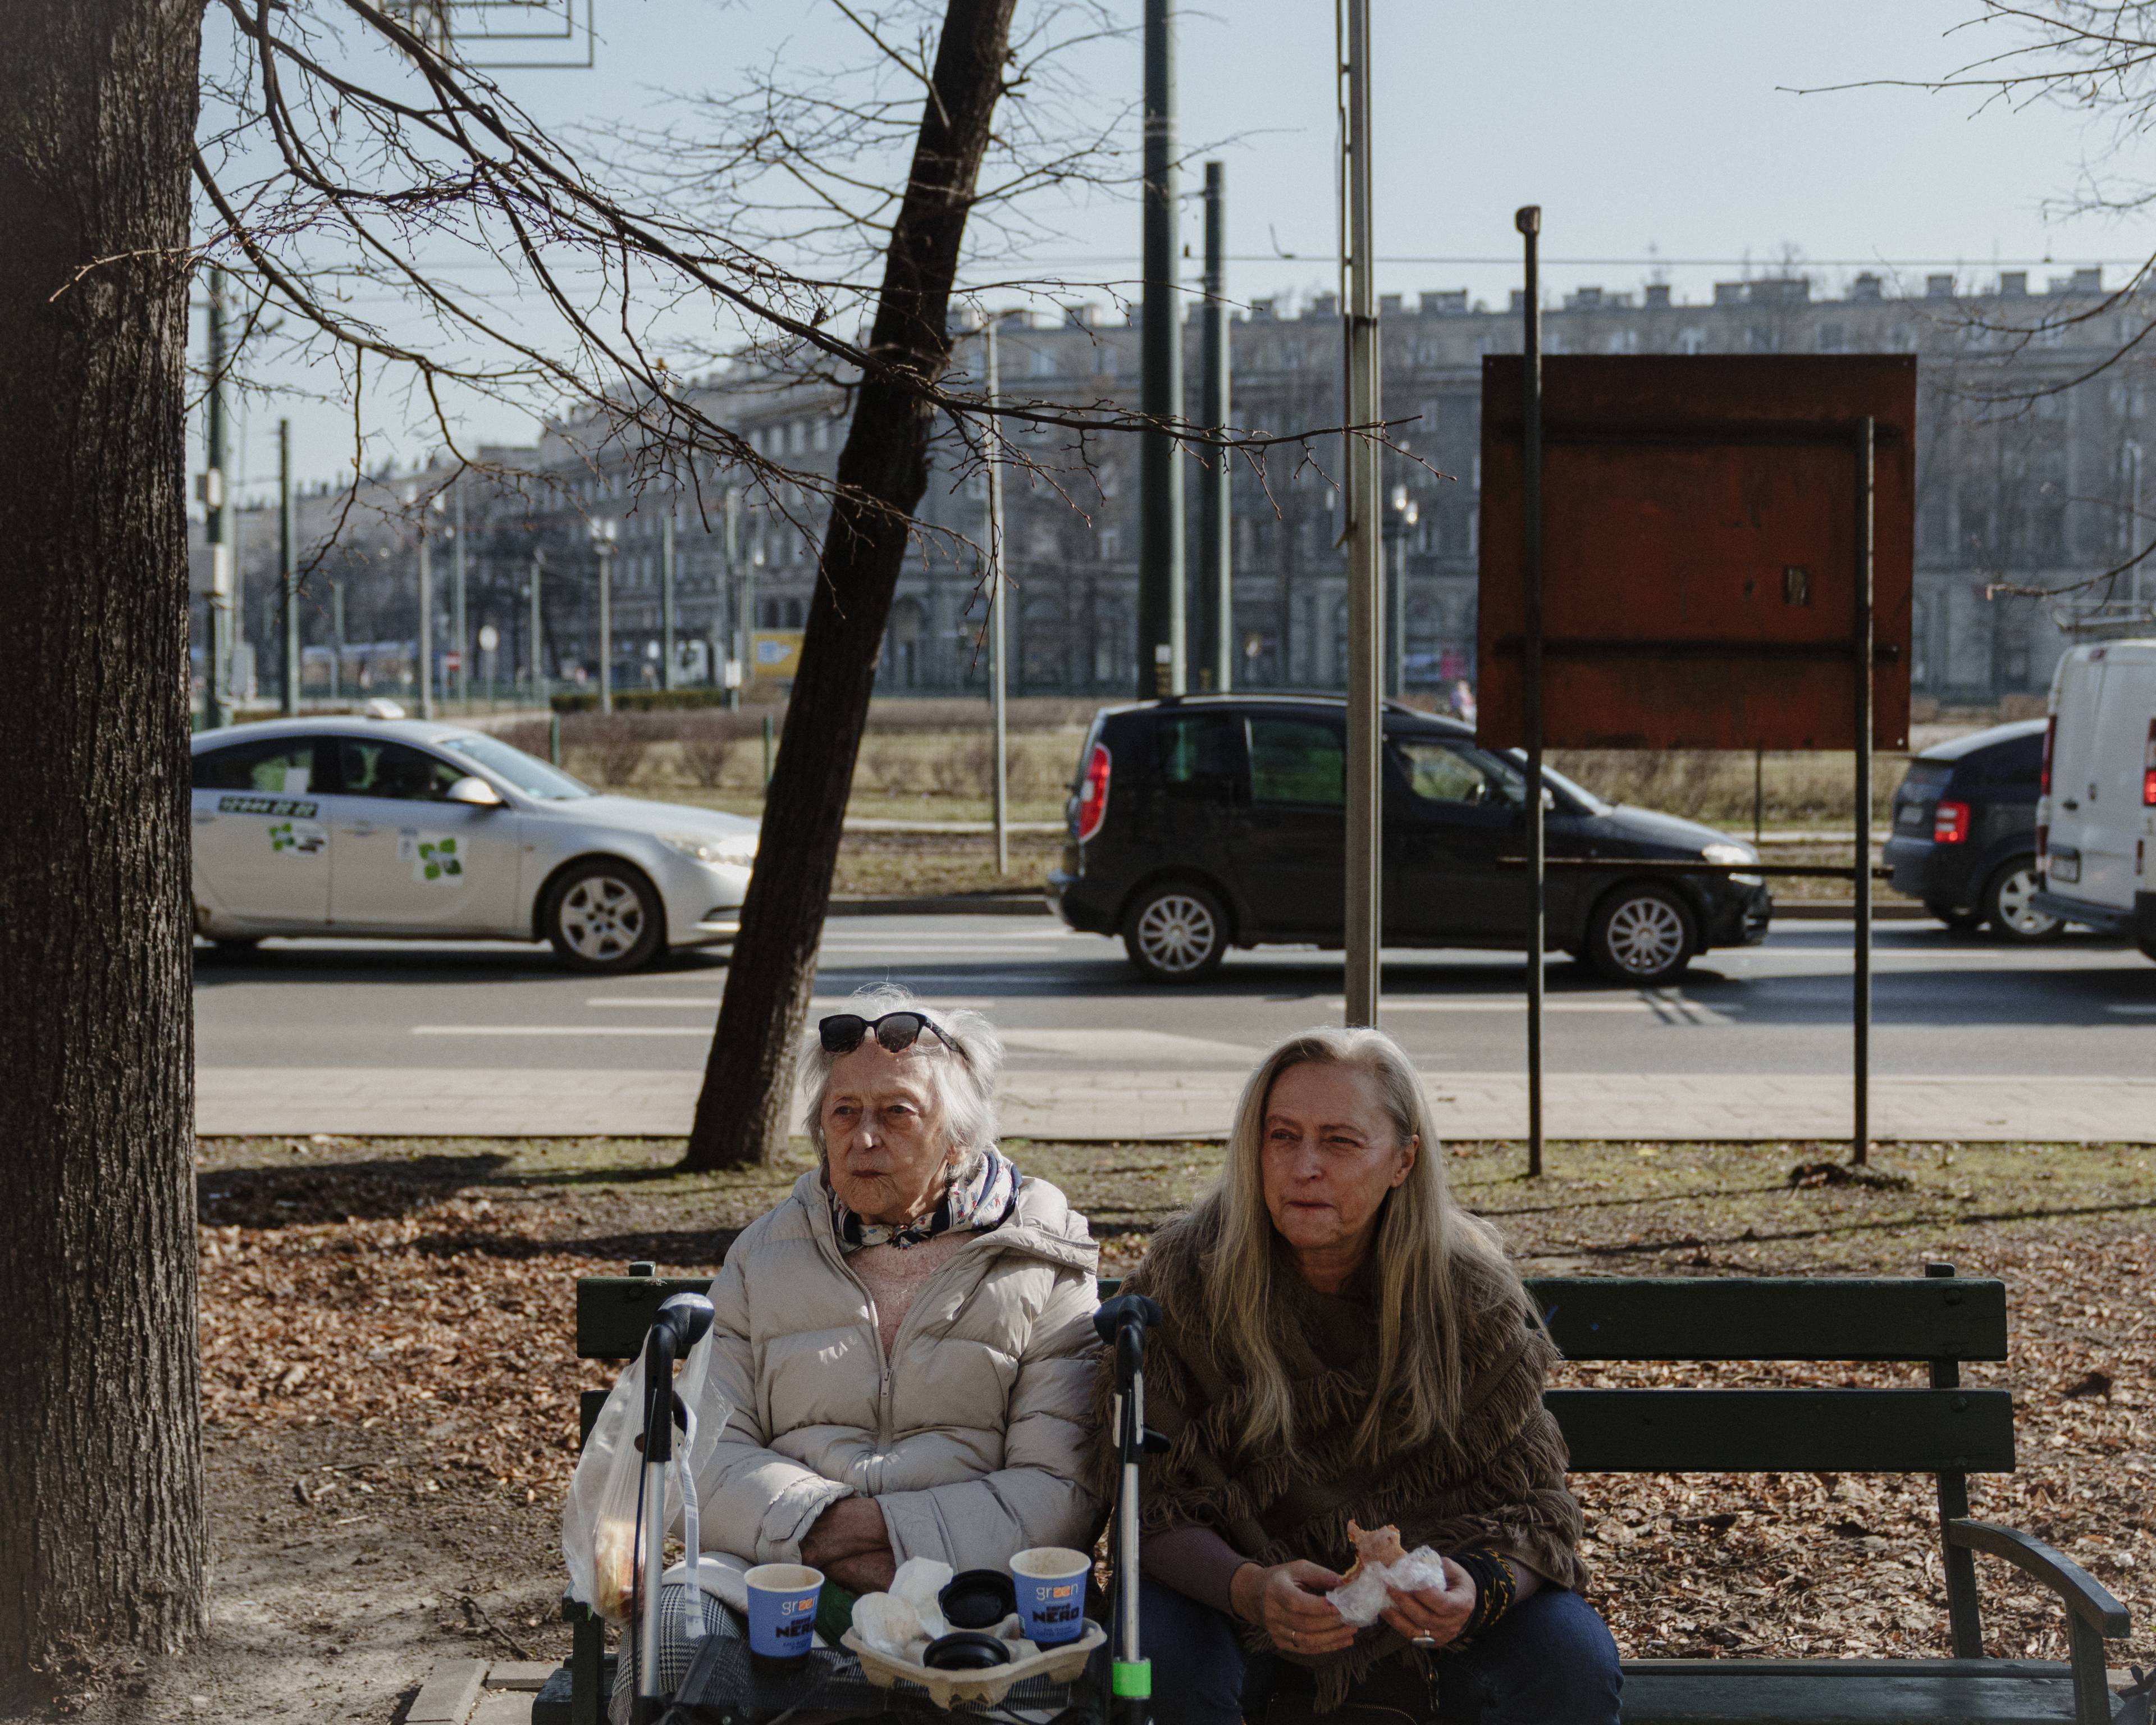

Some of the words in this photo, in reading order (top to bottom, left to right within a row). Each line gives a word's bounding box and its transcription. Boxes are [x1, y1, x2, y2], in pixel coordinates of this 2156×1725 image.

[1036, 1583, 1078, 1601] green
[782, 1595, 817, 1616] green
[1032, 1607, 1079, 1623] NERO
